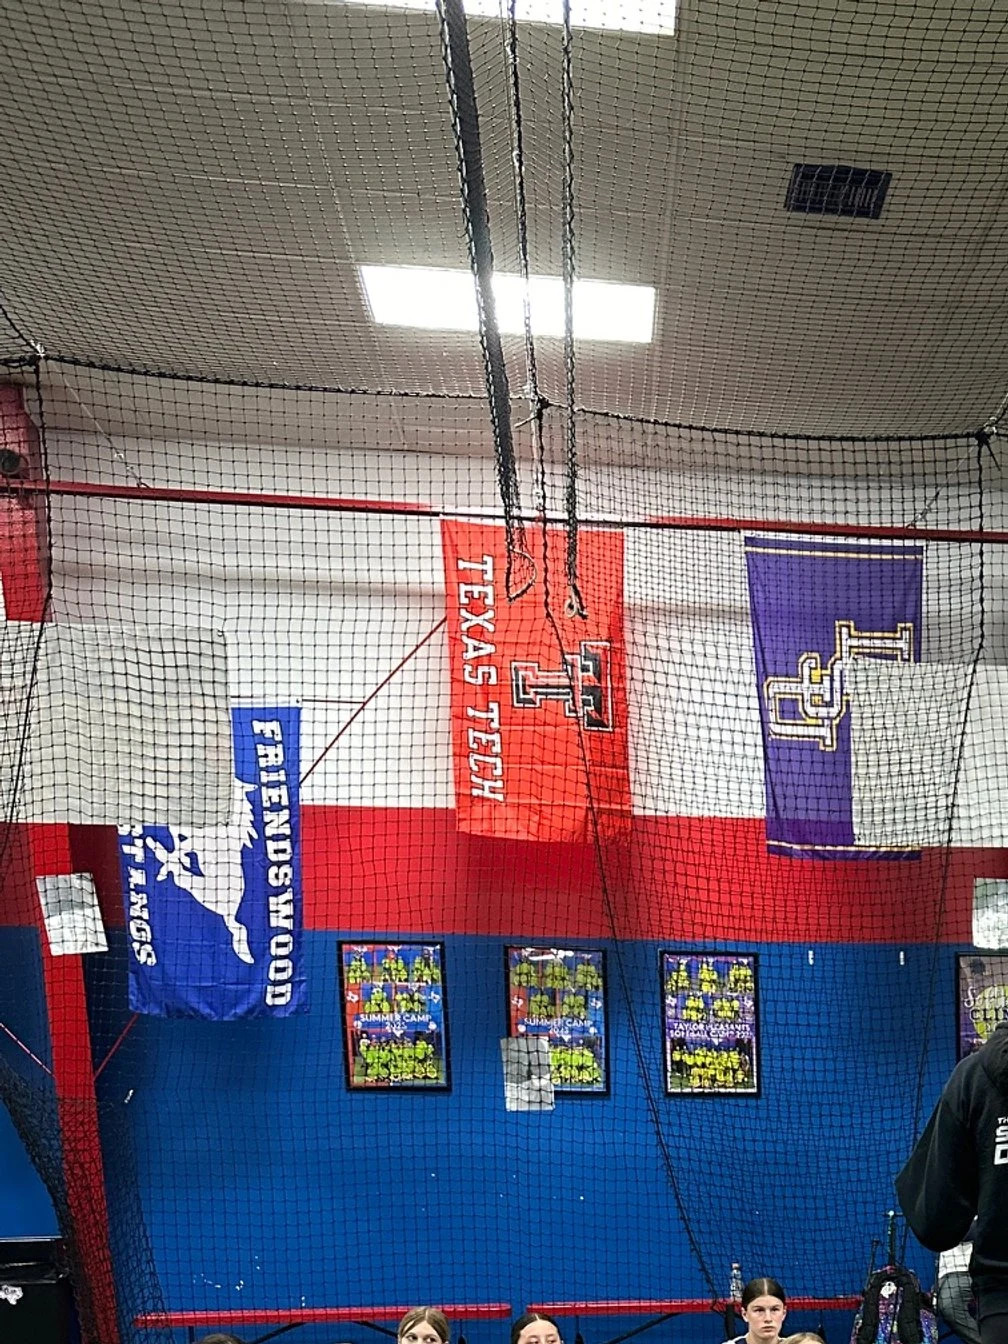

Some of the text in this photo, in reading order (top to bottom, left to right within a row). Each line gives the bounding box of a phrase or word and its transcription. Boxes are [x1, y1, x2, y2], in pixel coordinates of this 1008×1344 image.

[457, 553, 505, 803] TEXAS TECH
[252, 719, 294, 1007] FRIENDSWOOD
